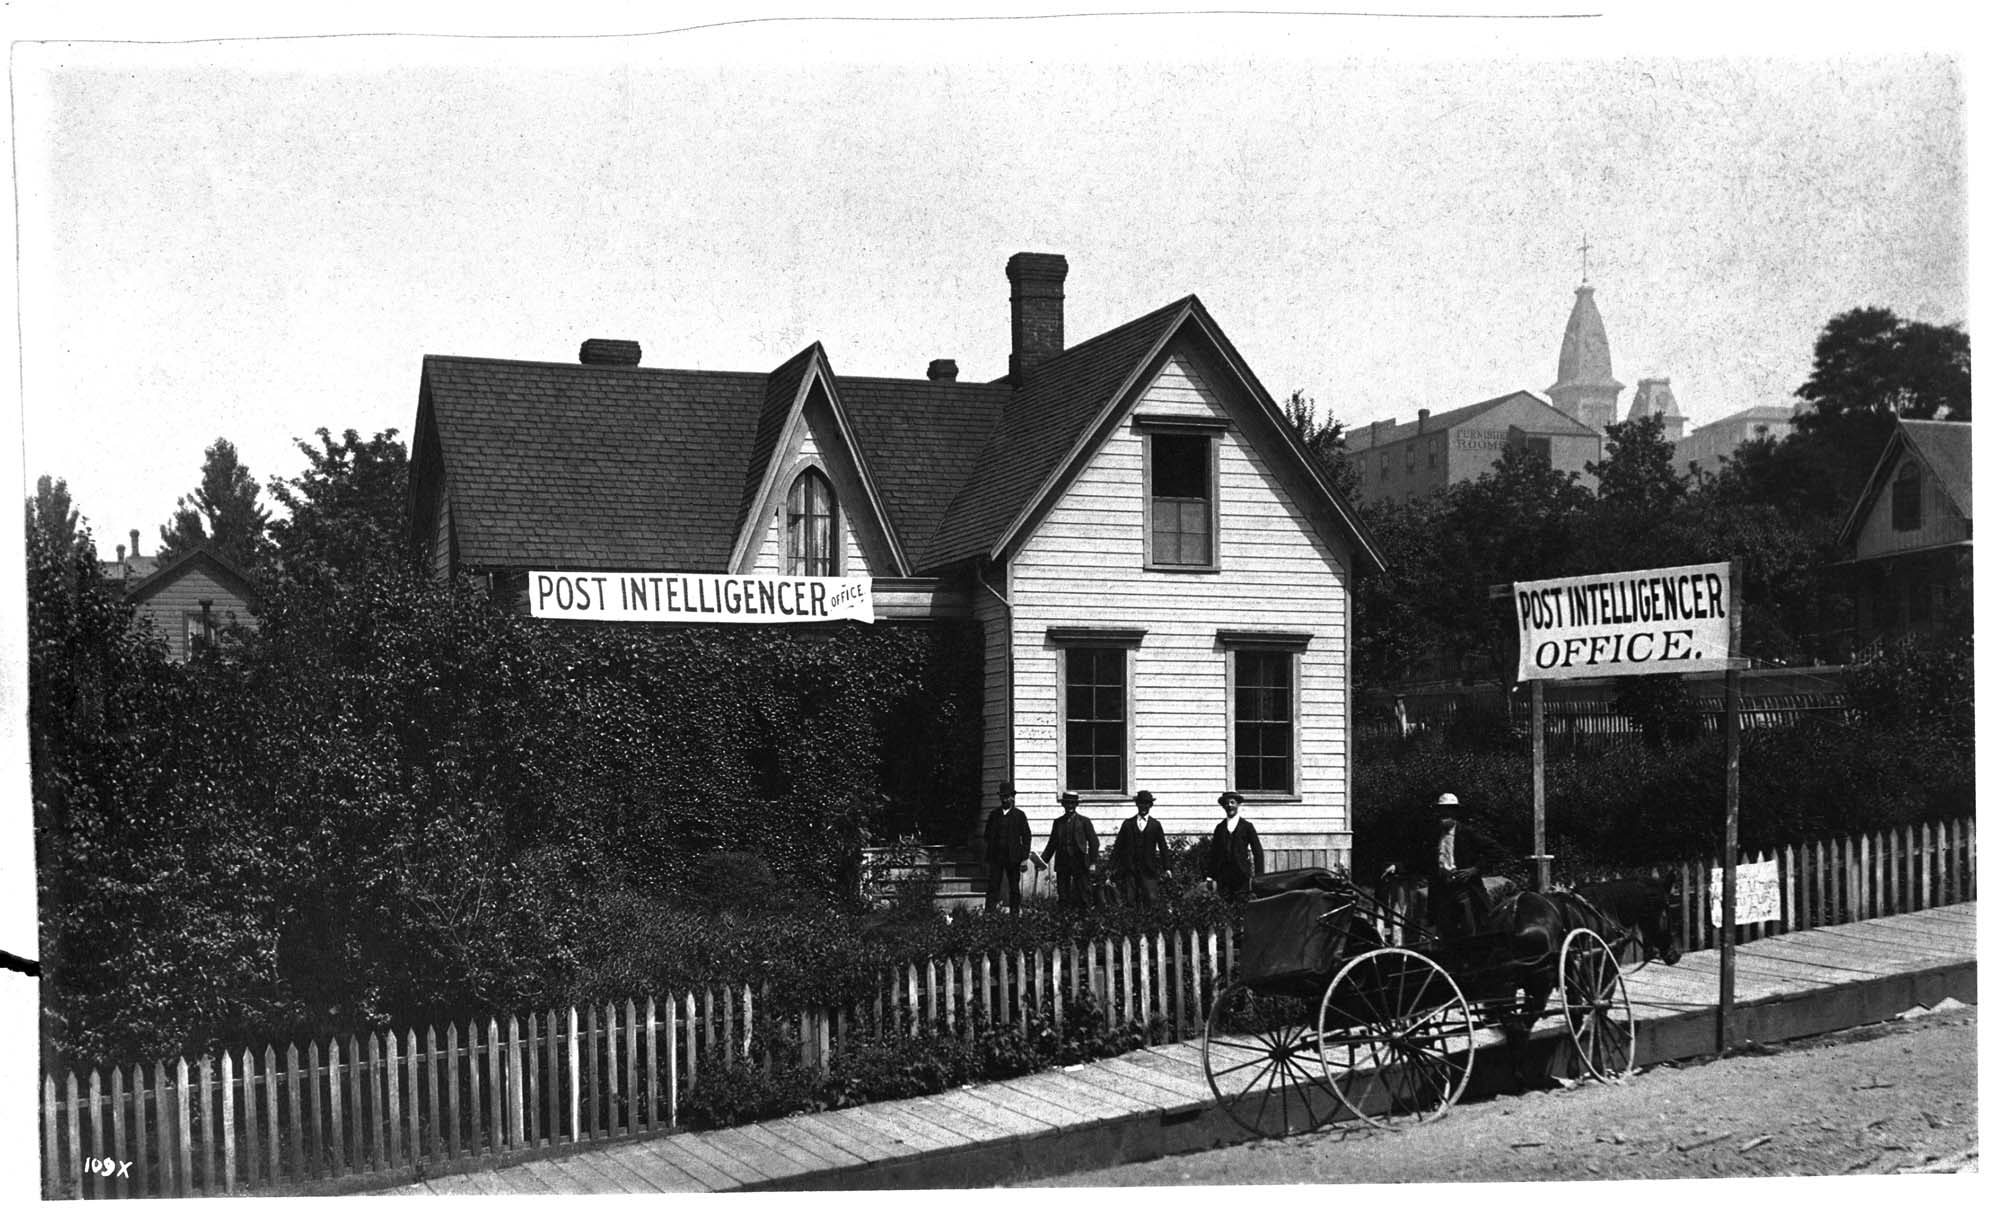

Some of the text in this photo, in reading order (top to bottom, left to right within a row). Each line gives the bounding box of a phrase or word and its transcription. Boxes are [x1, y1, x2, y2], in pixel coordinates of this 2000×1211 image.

[537, 574, 608, 611] POST
[620, 576, 829, 617] INTELLIGENCER
[1519, 572, 1726, 631] POST INTELLIGENCER
[1535, 629, 1703, 670] OFFICE.
